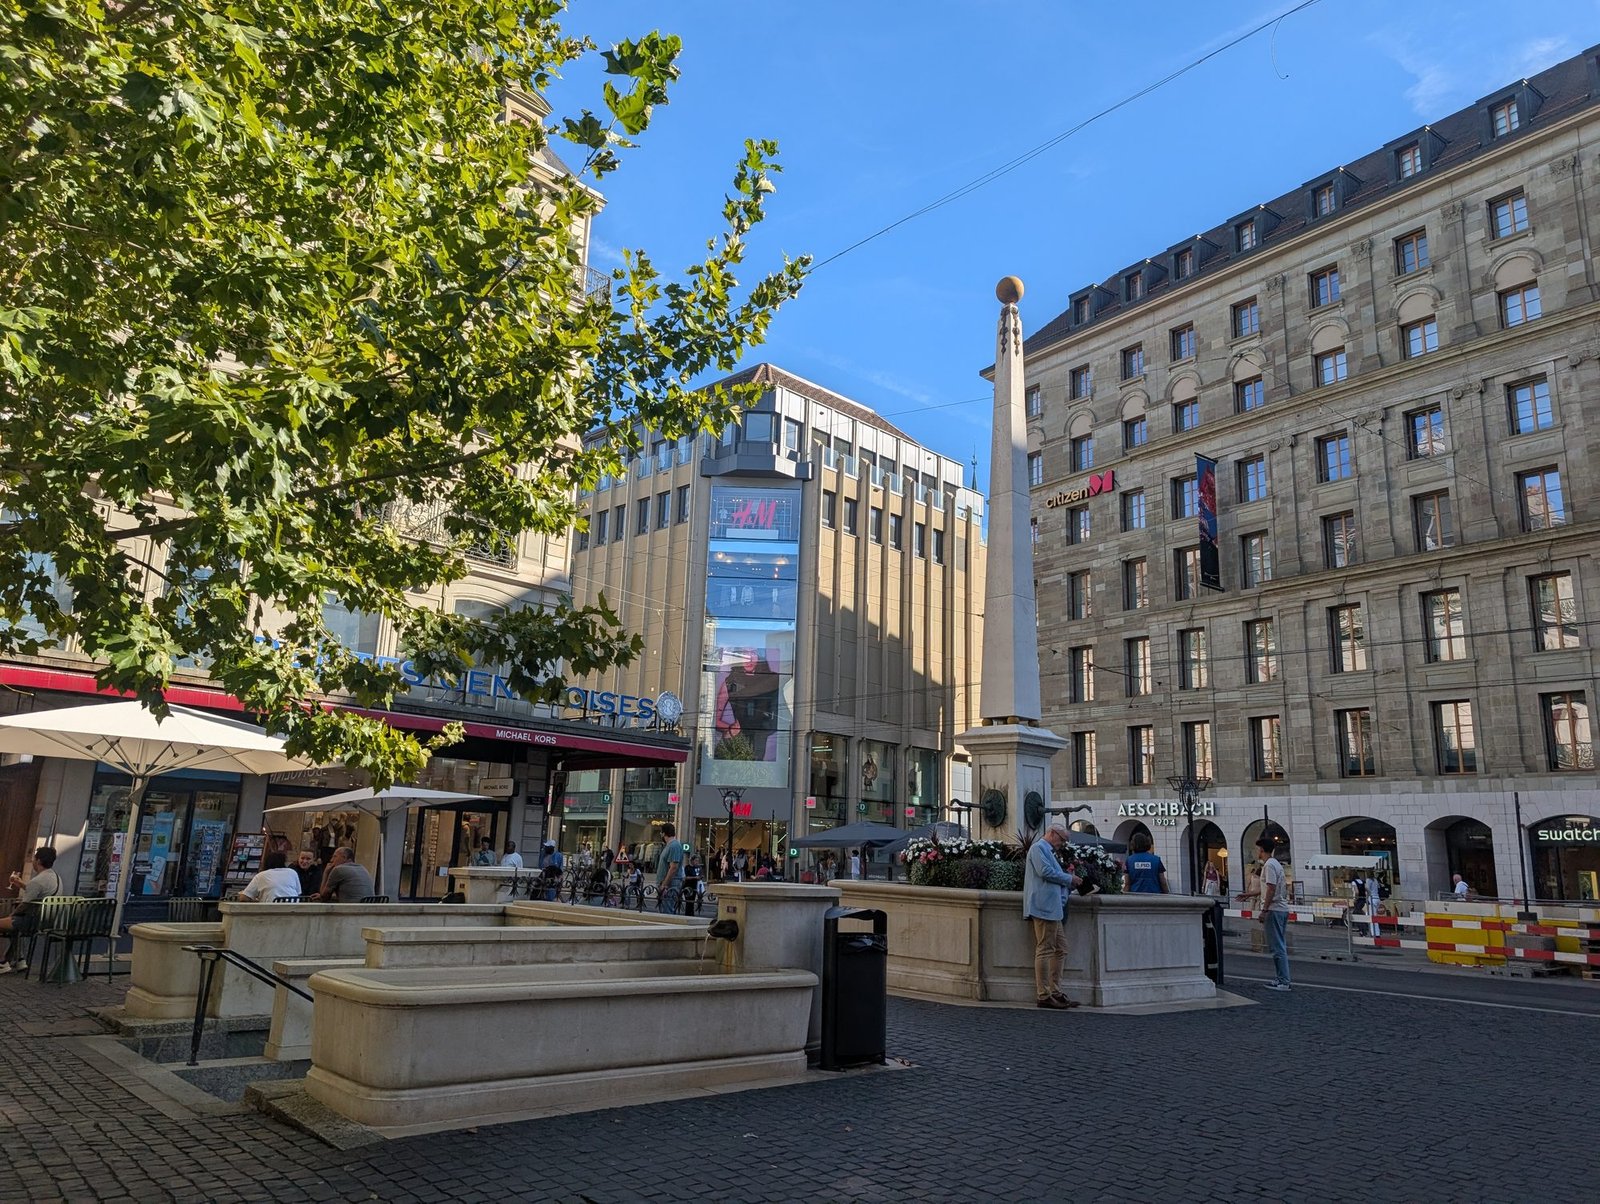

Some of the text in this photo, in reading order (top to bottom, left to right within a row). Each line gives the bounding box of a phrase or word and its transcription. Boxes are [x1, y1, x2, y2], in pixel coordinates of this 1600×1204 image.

[495, 729, 557, 745] MICHAEL KORS
[1151, 818, 1176, 827] 1904
